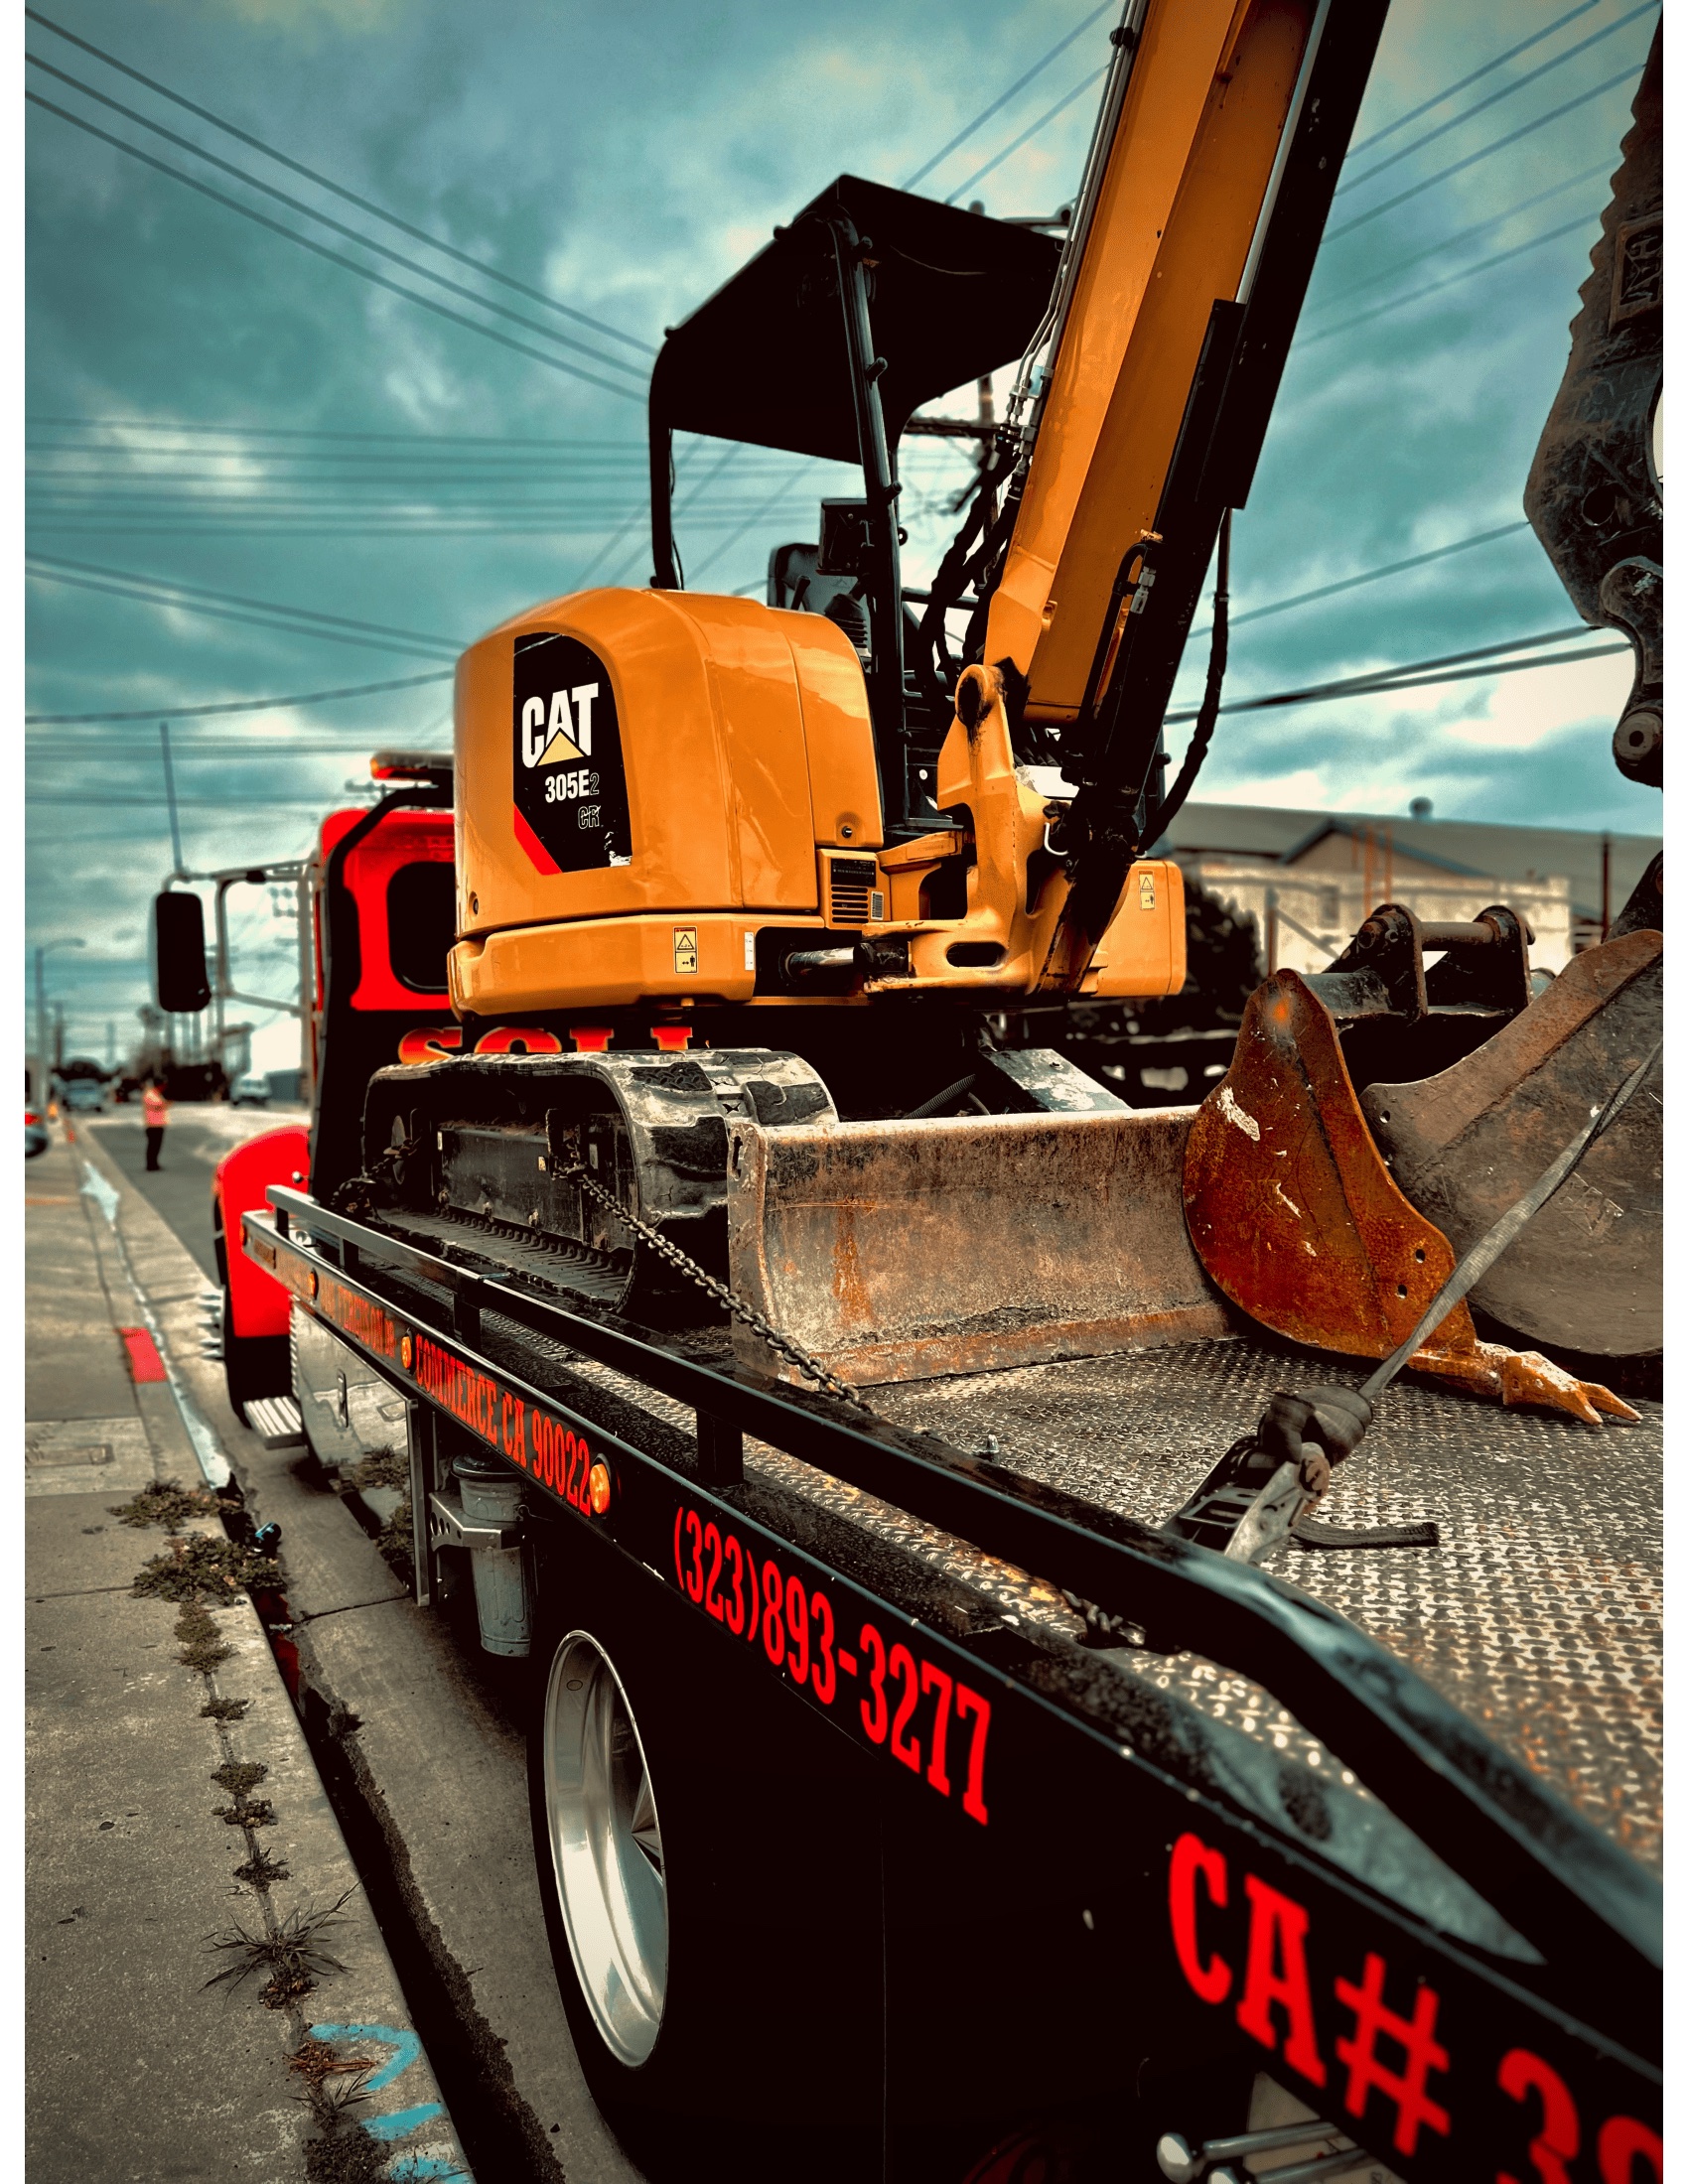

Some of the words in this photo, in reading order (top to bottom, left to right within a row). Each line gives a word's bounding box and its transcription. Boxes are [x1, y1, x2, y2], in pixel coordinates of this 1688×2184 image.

[521, 682, 599, 768] CAT
[577, 805, 600, 830] CR
[415, 1333, 497, 1445] COMMERCE
[502, 1391, 527, 1468] CA
[532, 1409, 592, 1518] 90022
[674, 1506, 991, 1827] (323)893-3277
[1169, 1832, 1450, 2158] CA#
